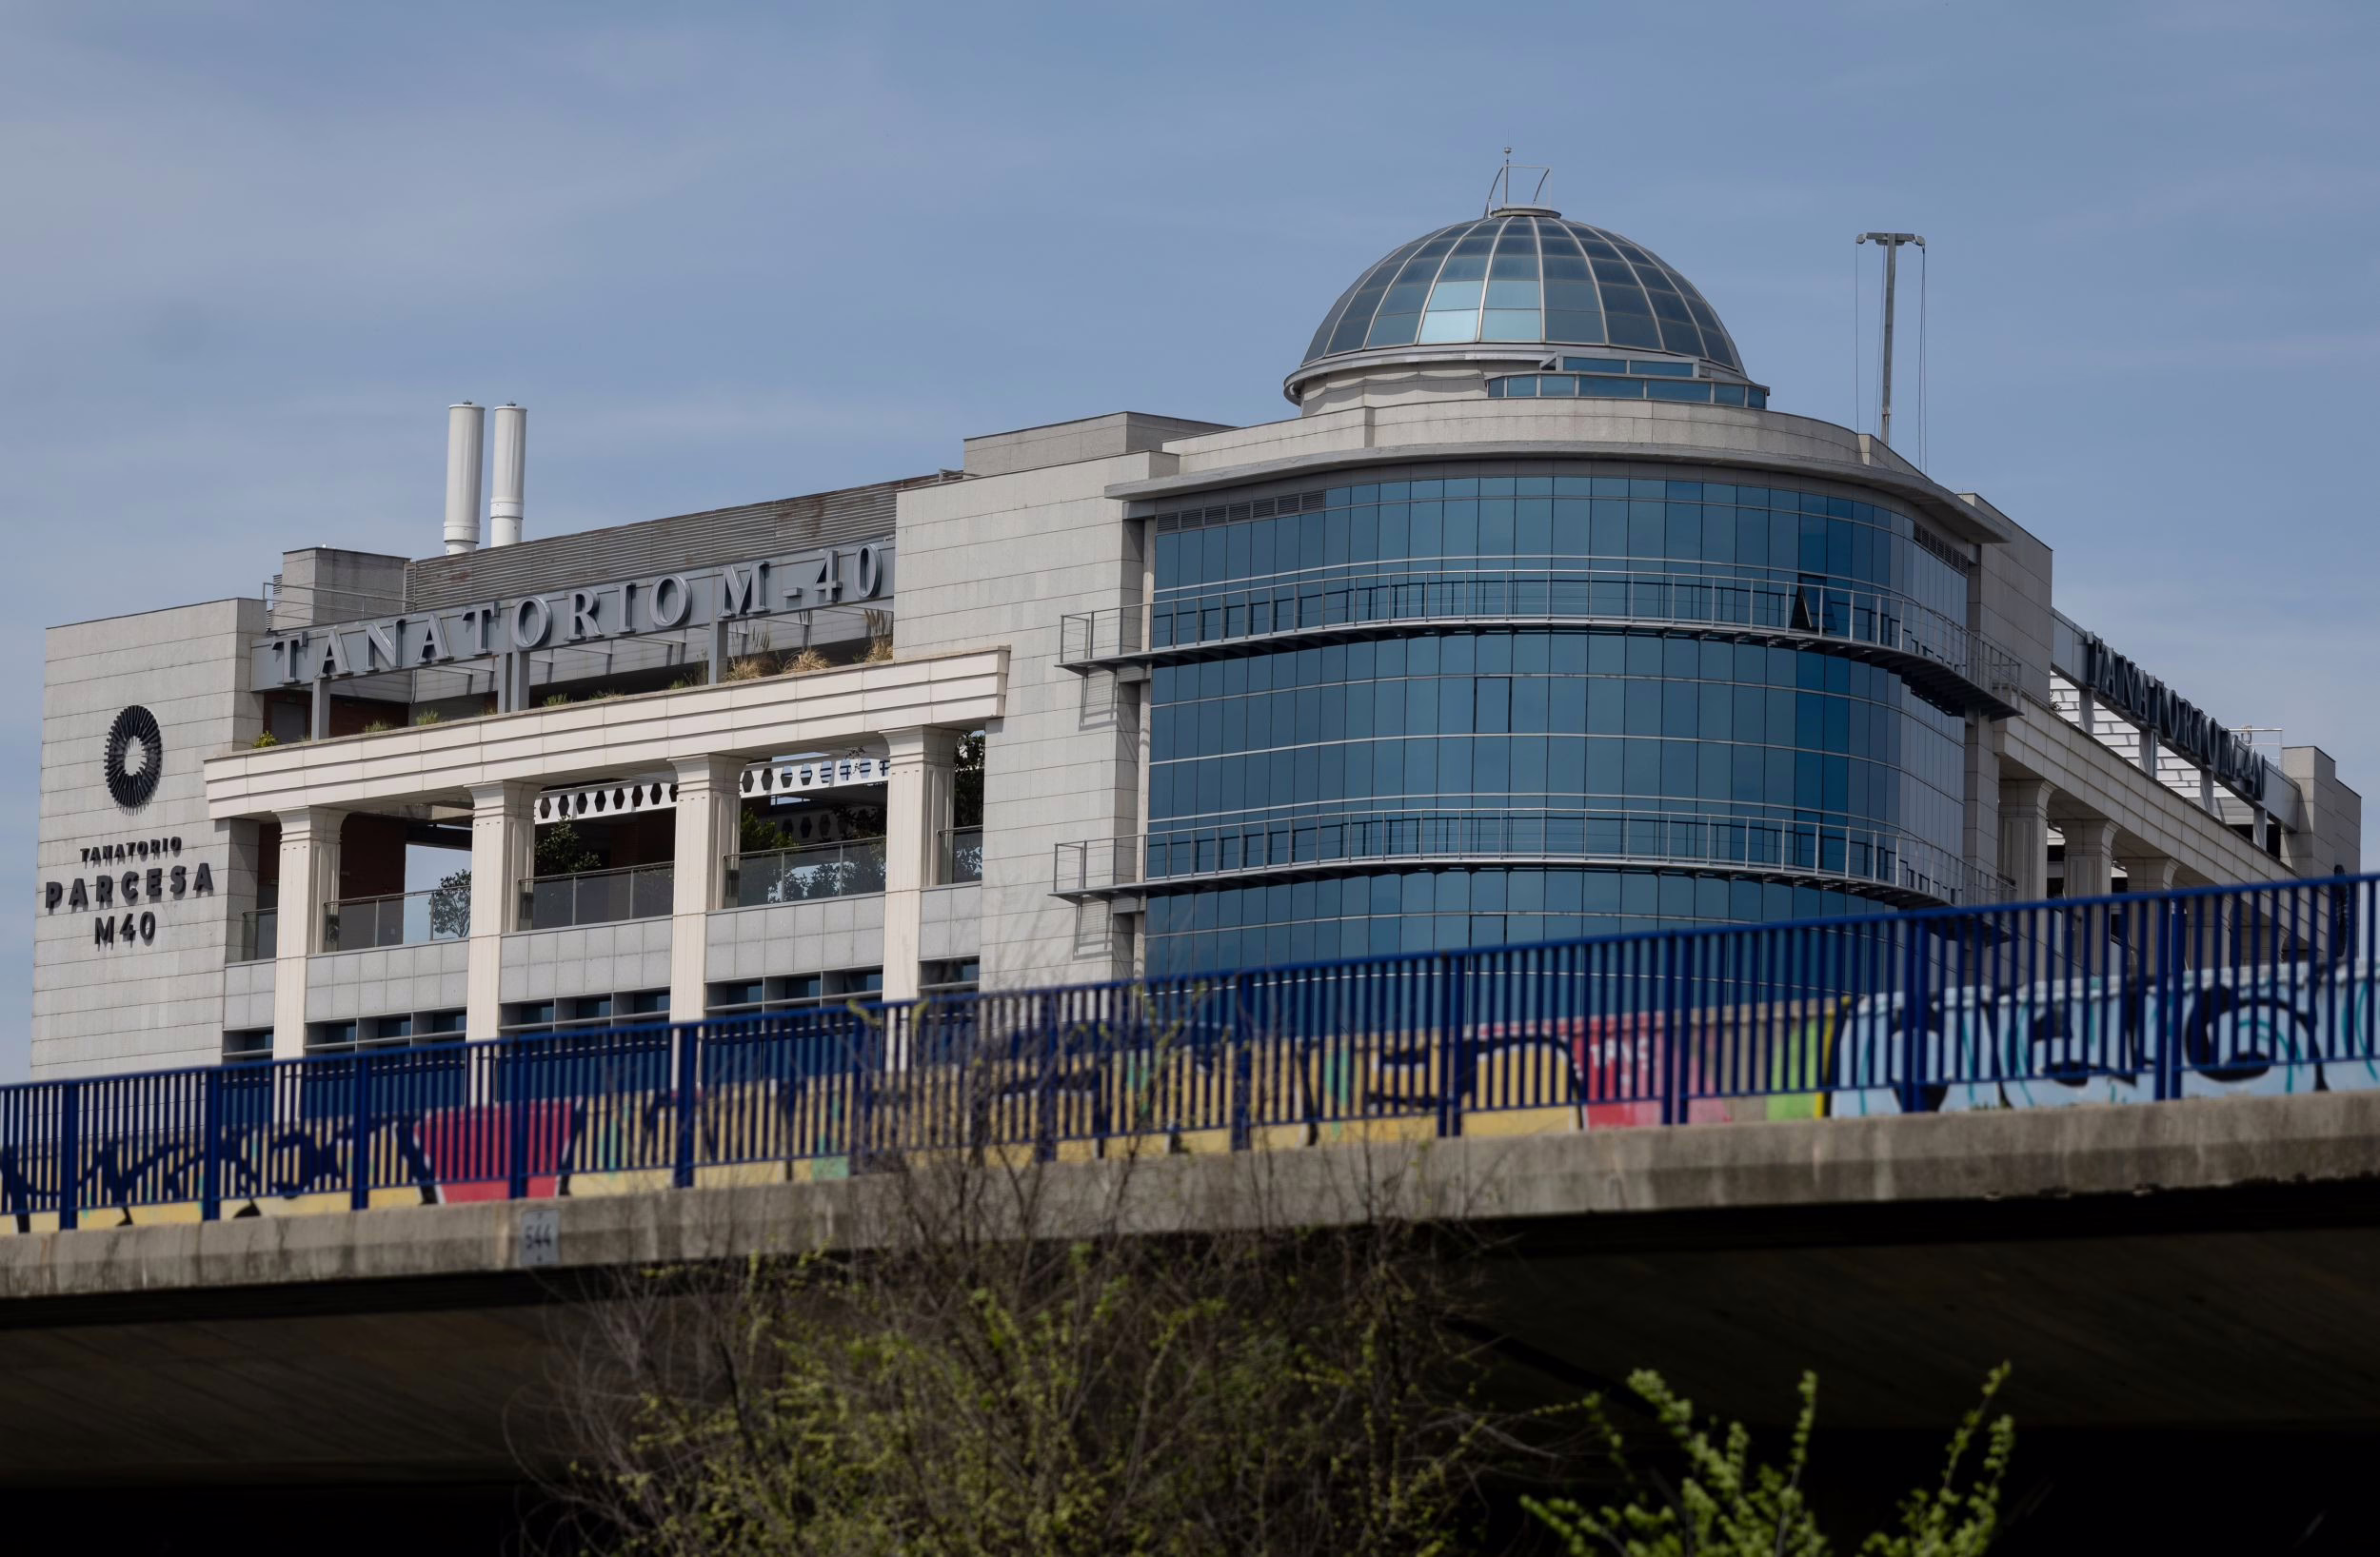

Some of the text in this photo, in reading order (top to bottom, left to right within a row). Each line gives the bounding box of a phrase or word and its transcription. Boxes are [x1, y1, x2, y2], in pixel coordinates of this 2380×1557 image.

[271, 542, 883, 684] TANATORIO M-40
[80, 837, 182, 862] TANATORIO
[45, 862, 214, 909] PARCESA
[94, 911, 156, 945] M40
